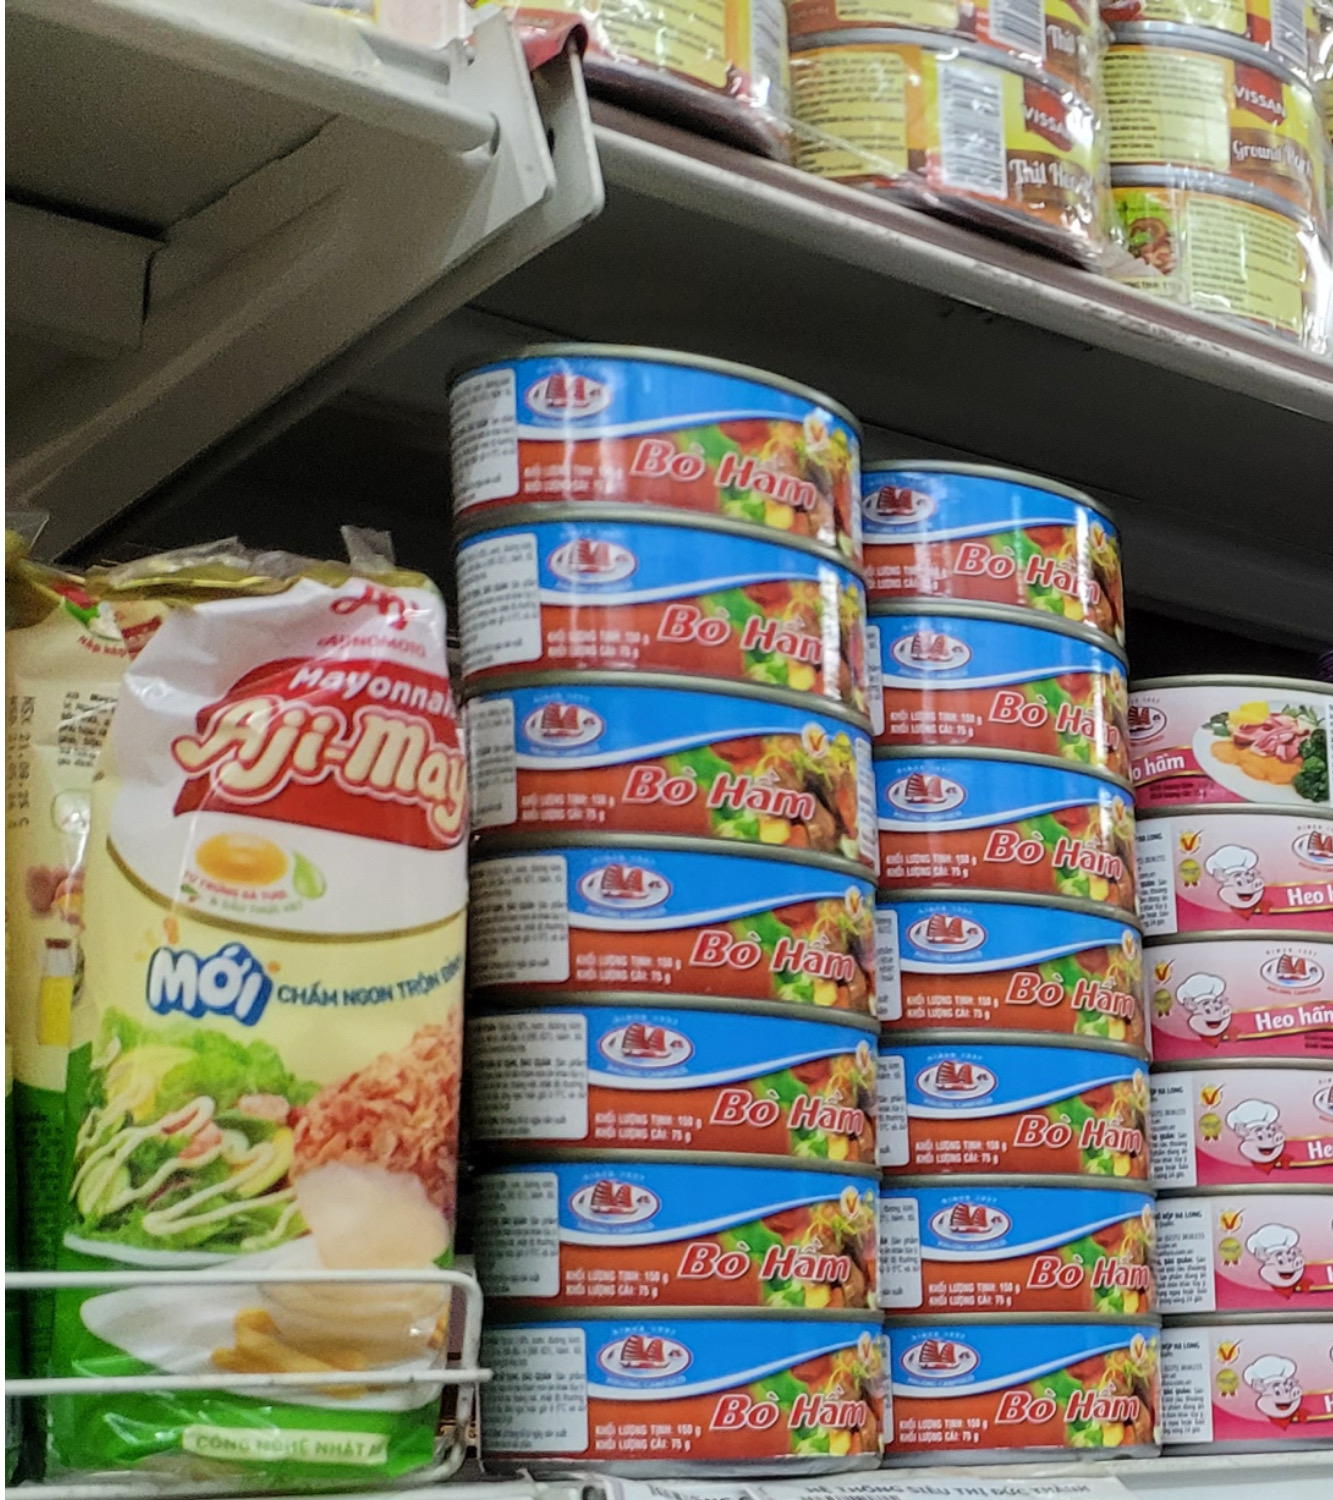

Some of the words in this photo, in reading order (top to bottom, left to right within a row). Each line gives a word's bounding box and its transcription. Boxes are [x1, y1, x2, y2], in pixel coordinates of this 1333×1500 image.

[631, 438, 704, 481] Bò
[715, 452, 816, 508] Hầm
[172, 695, 468, 845] Aji-May
[622, 766, 696, 801] Bò
[706, 774, 816, 820] Hầm
[1286, 886, 1322, 909] Heo
[148, 943, 267, 1024] MỚI
[277, 980, 339, 1008] CHẤM
[342, 986, 393, 1008] NGON
[709, 1394, 780, 1431] Bò
[790, 1386, 866, 1427] Hầm
